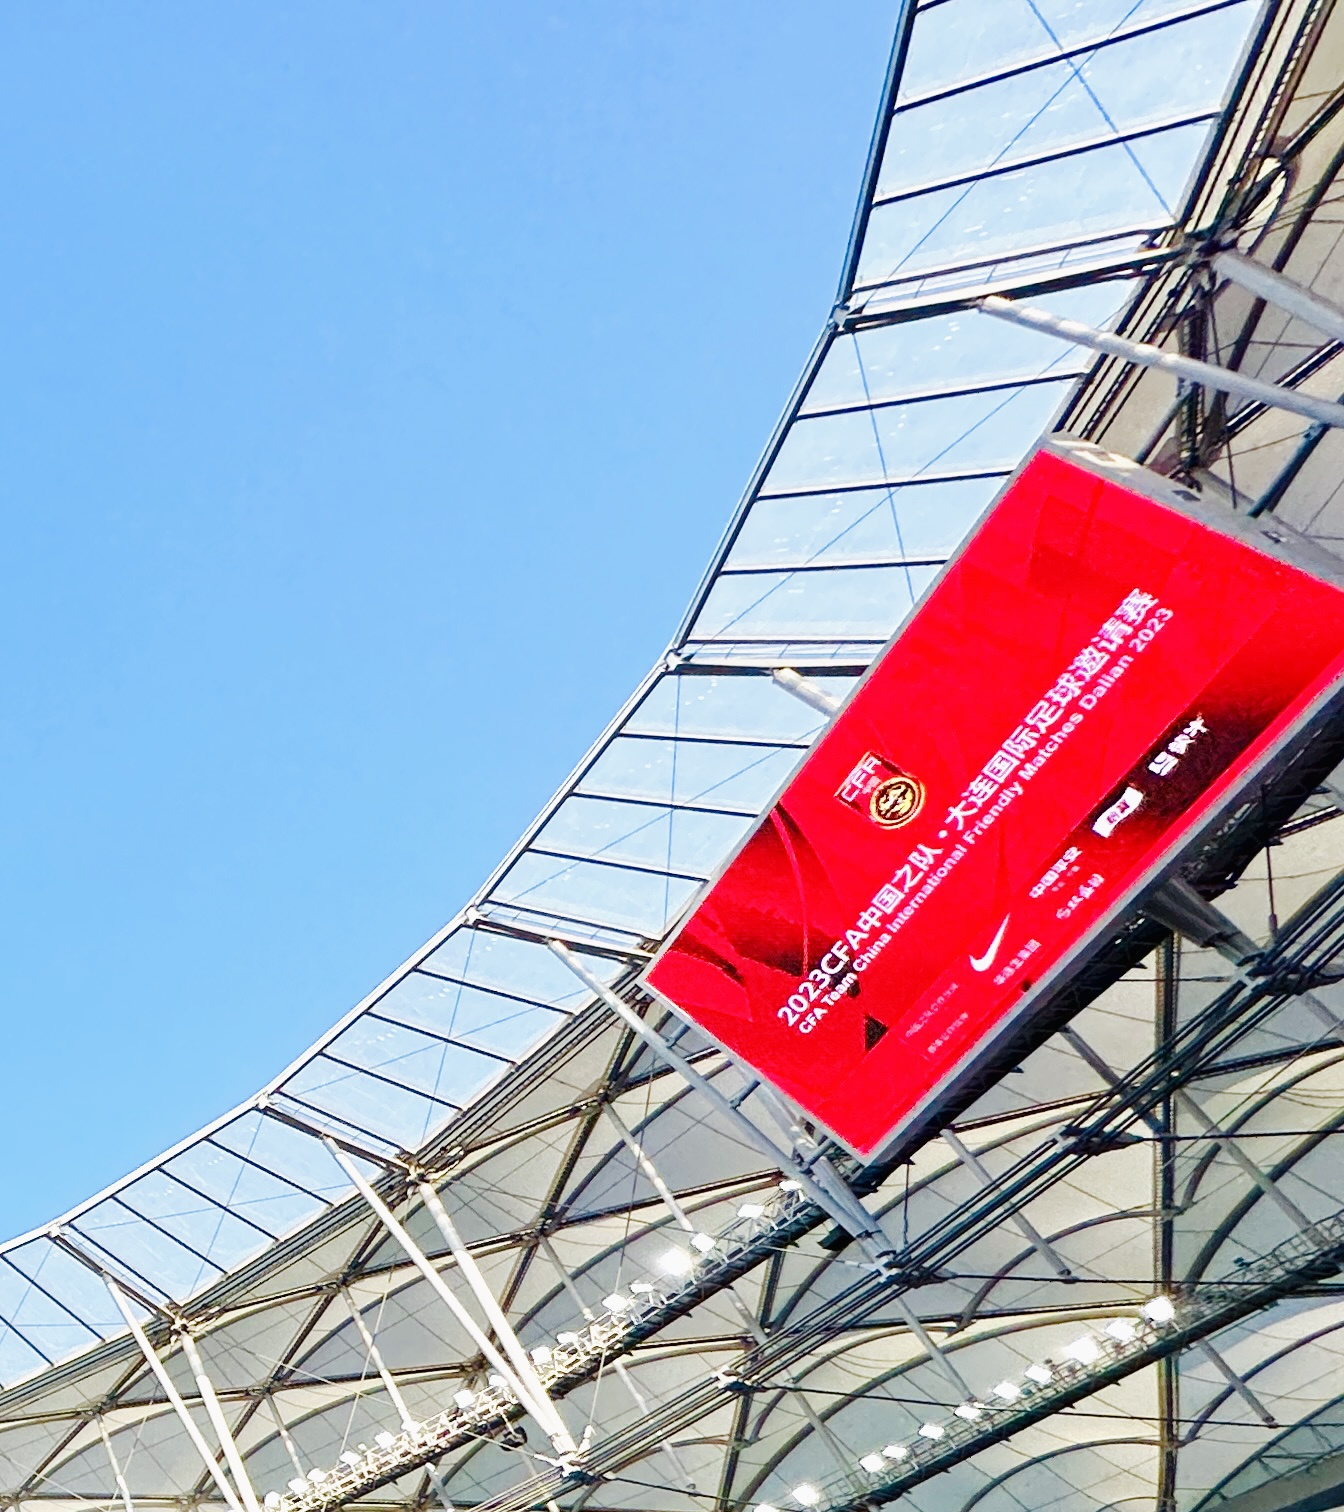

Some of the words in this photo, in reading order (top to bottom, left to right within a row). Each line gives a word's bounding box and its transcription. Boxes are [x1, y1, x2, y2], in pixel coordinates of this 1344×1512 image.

[798, 1007, 829, 1034] CFA
[820, 972, 858, 1006] Team
[852, 932, 892, 972] China
[885, 843, 968, 934] International
[963, 780, 1024, 845] Friendly
[1017, 712, 1084, 781] Matches
[1078, 654, 1134, 711] Dalian
[1128, 607, 1174, 653] 2023
